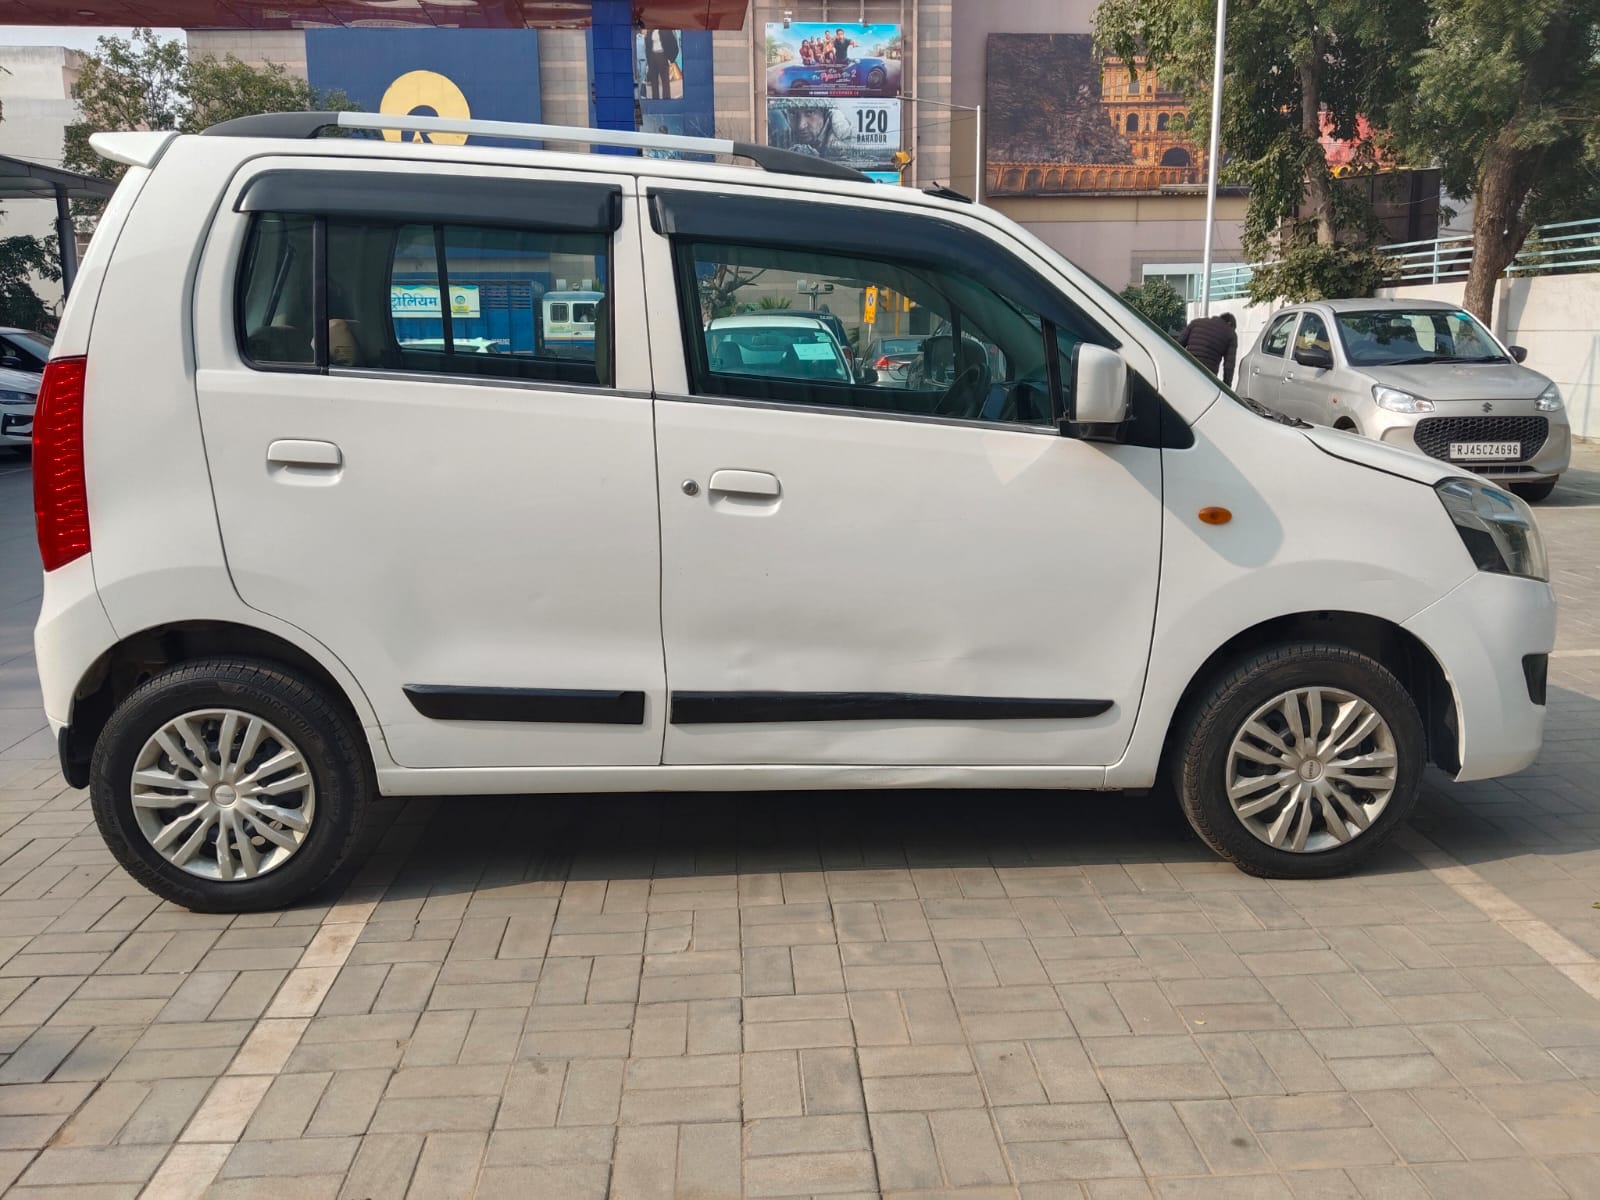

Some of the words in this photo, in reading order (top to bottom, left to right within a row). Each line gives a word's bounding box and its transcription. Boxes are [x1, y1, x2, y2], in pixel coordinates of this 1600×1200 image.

[851, 69, 857, 78] 2
[856, 109, 888, 133] 120
[856, 134, 887, 143] BAHADUR
[1456, 444, 1519, 455] RJ45CZ4696
